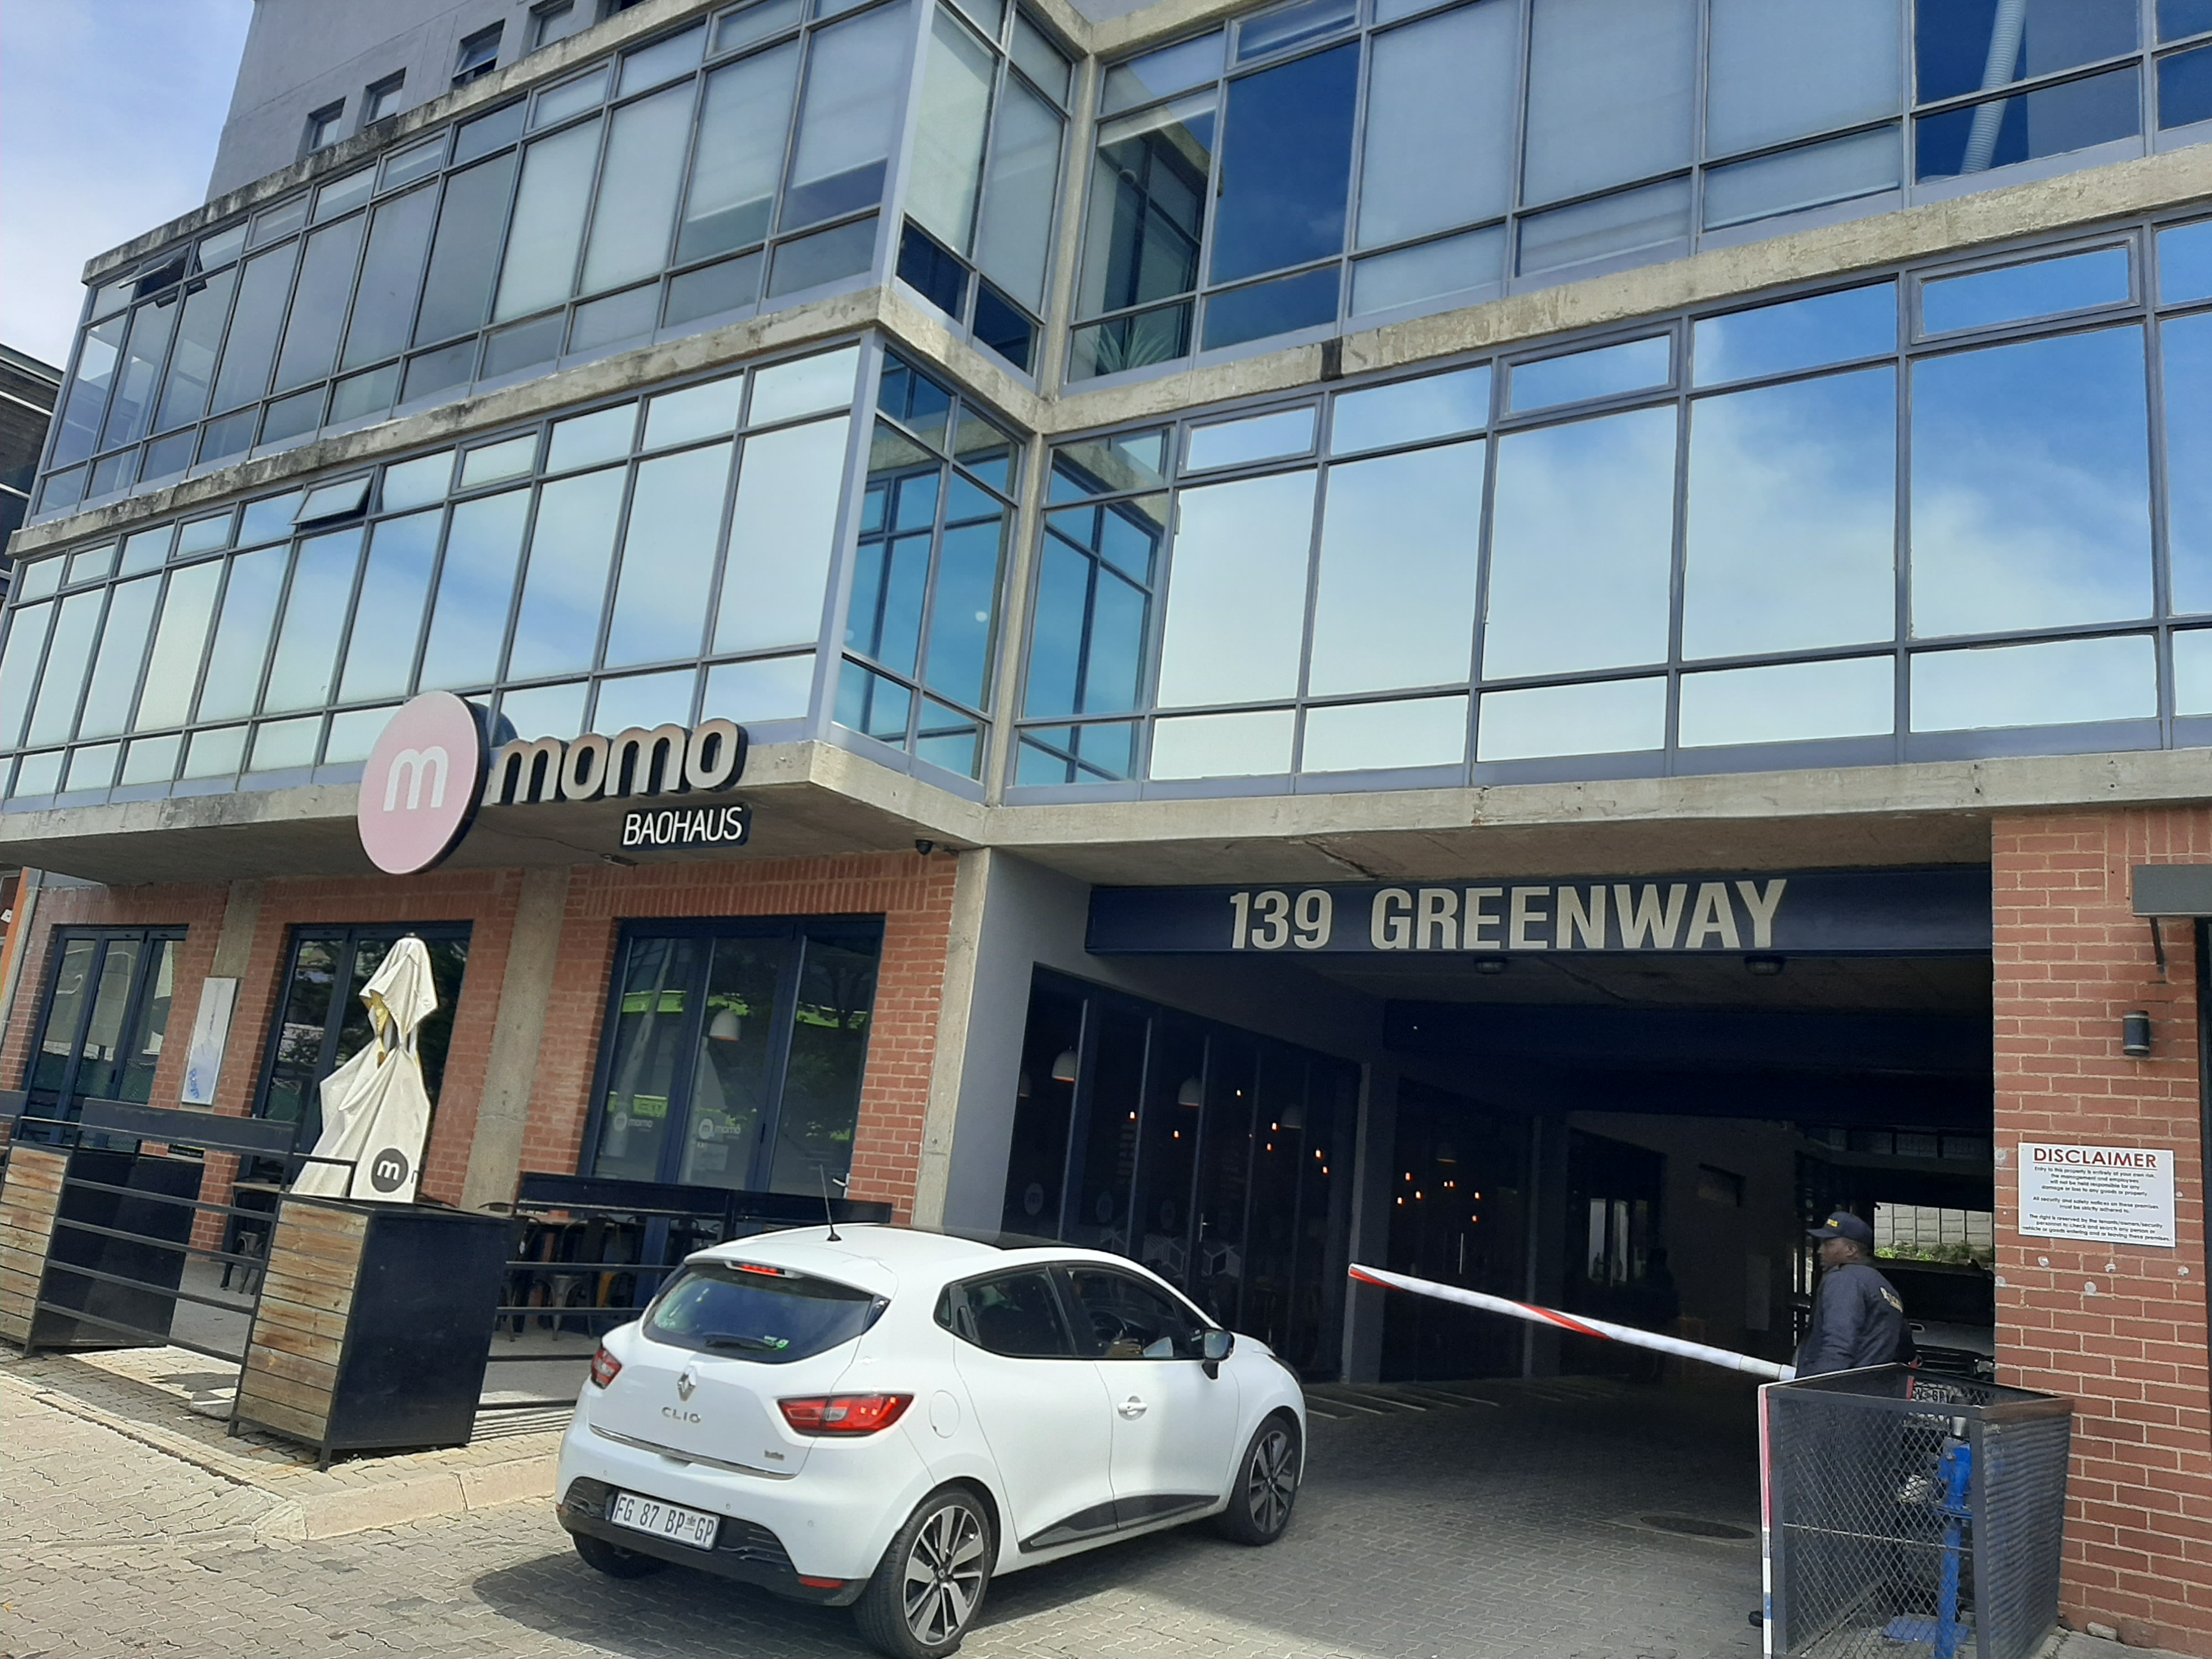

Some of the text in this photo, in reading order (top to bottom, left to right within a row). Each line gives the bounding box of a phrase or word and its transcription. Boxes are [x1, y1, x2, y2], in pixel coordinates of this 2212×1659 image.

[383, 745, 449, 812] m
[491, 718, 744, 806] momo
[622, 806, 743, 846] BAOHAUS
[1229, 879, 1788, 951] 139 GREENWAY
[377, 1160, 399, 1181] m
[2034, 1147, 2157, 1168] DISCLAIMER
[661, 1407, 701, 1423] CLIO
[614, 1496, 714, 1543] FG 87 BP GP
